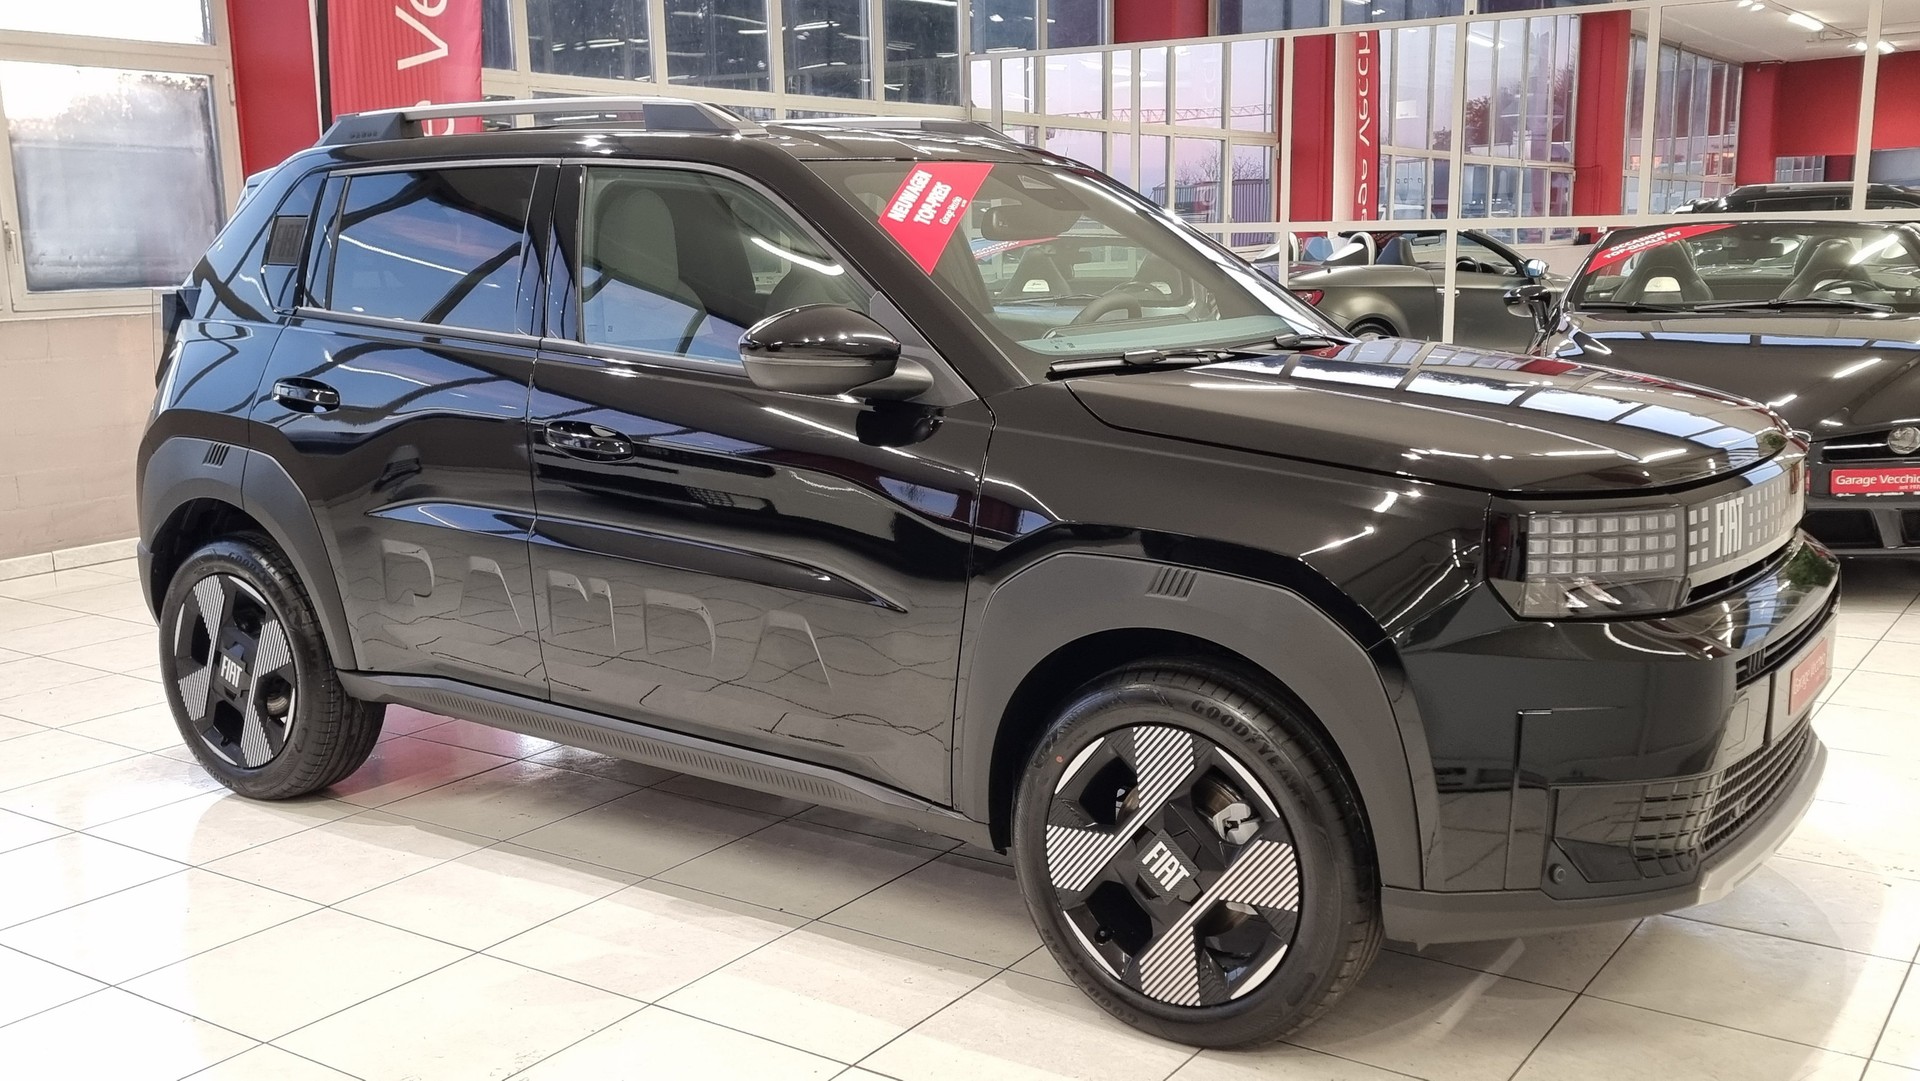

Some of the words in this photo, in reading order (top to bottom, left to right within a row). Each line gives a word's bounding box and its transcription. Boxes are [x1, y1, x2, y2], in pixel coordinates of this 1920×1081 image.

[887, 169, 933, 222] NEUWAGEN
[1610, 231, 1666, 251] OCCASION
[1836, 475, 1877, 487] Garage
[1715, 496, 1744, 559] FIAT
[381, 539, 833, 694] PANDA
[221, 655, 243, 688] FIAT
[1142, 841, 1190, 892] FIAT
